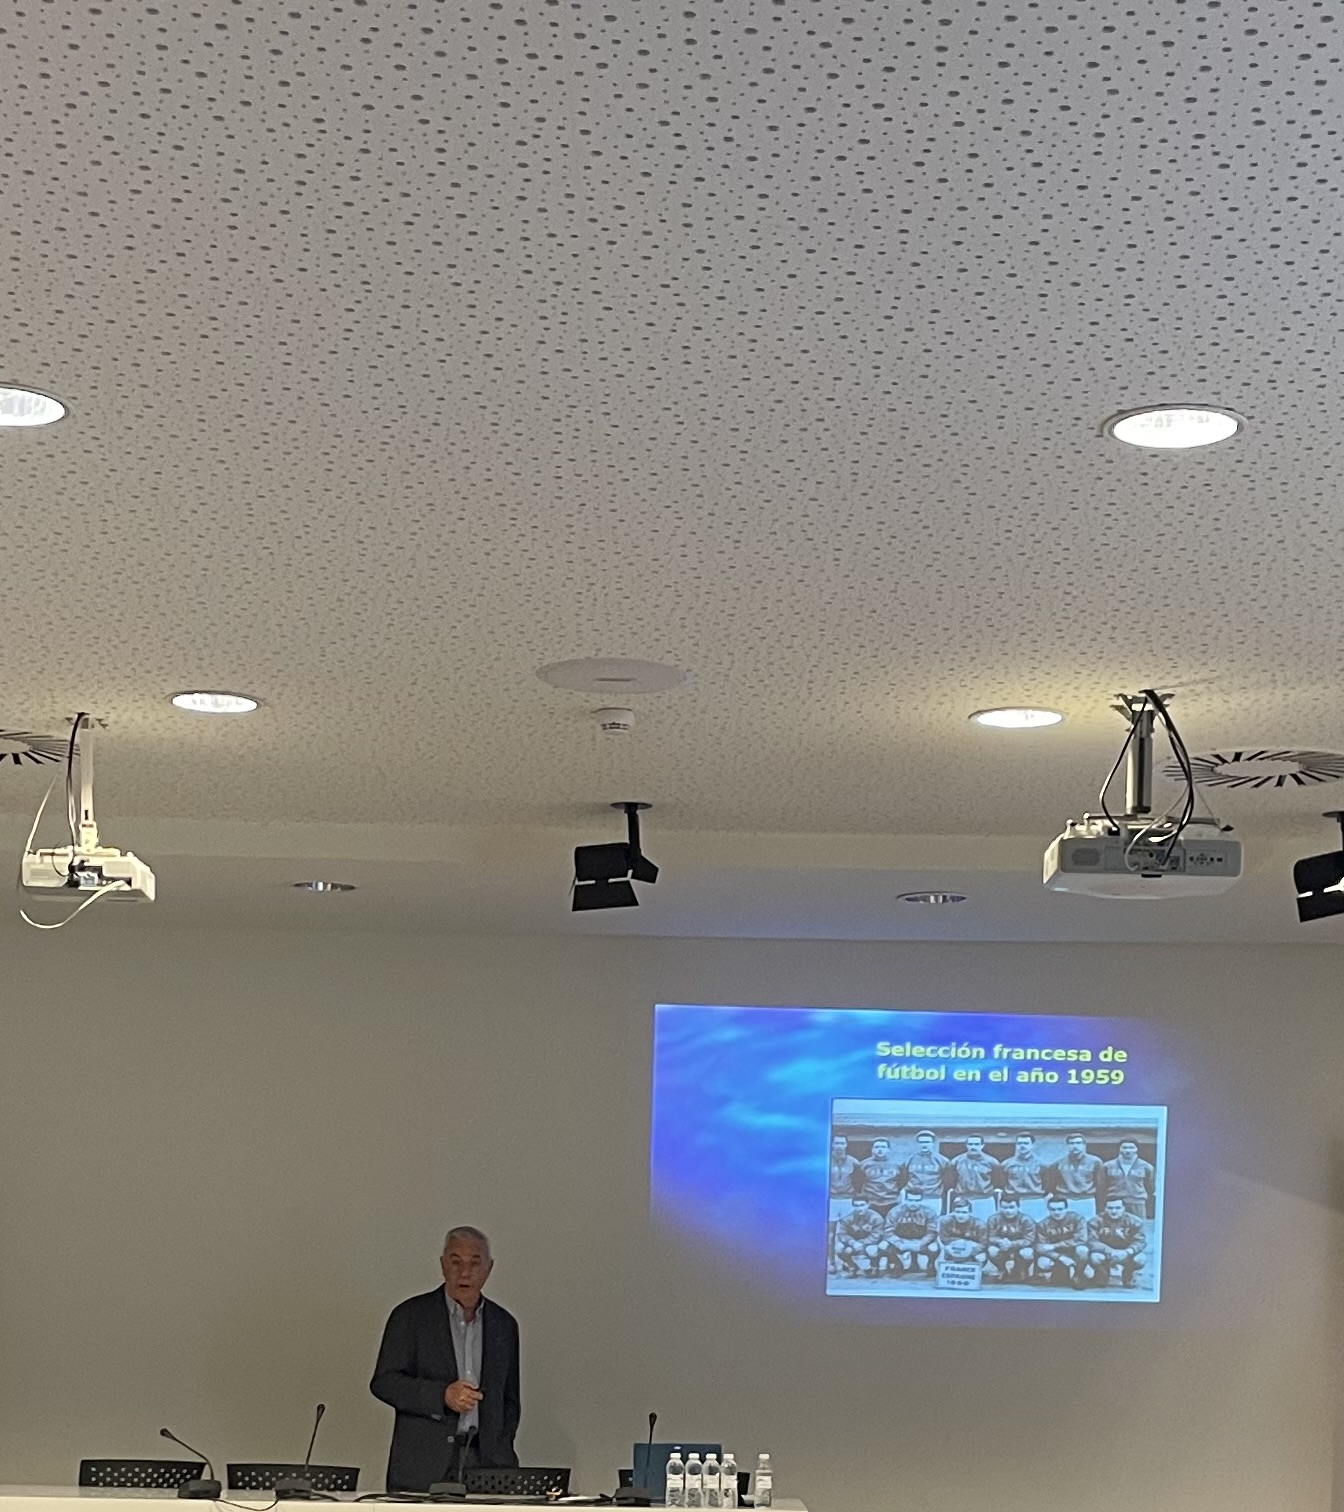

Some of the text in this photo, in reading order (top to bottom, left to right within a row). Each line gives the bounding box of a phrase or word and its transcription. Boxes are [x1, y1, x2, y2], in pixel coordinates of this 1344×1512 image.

[876, 1041, 1128, 1063] Selección francesa de
[877, 1063, 1125, 1085] fútbol en el año 1959
